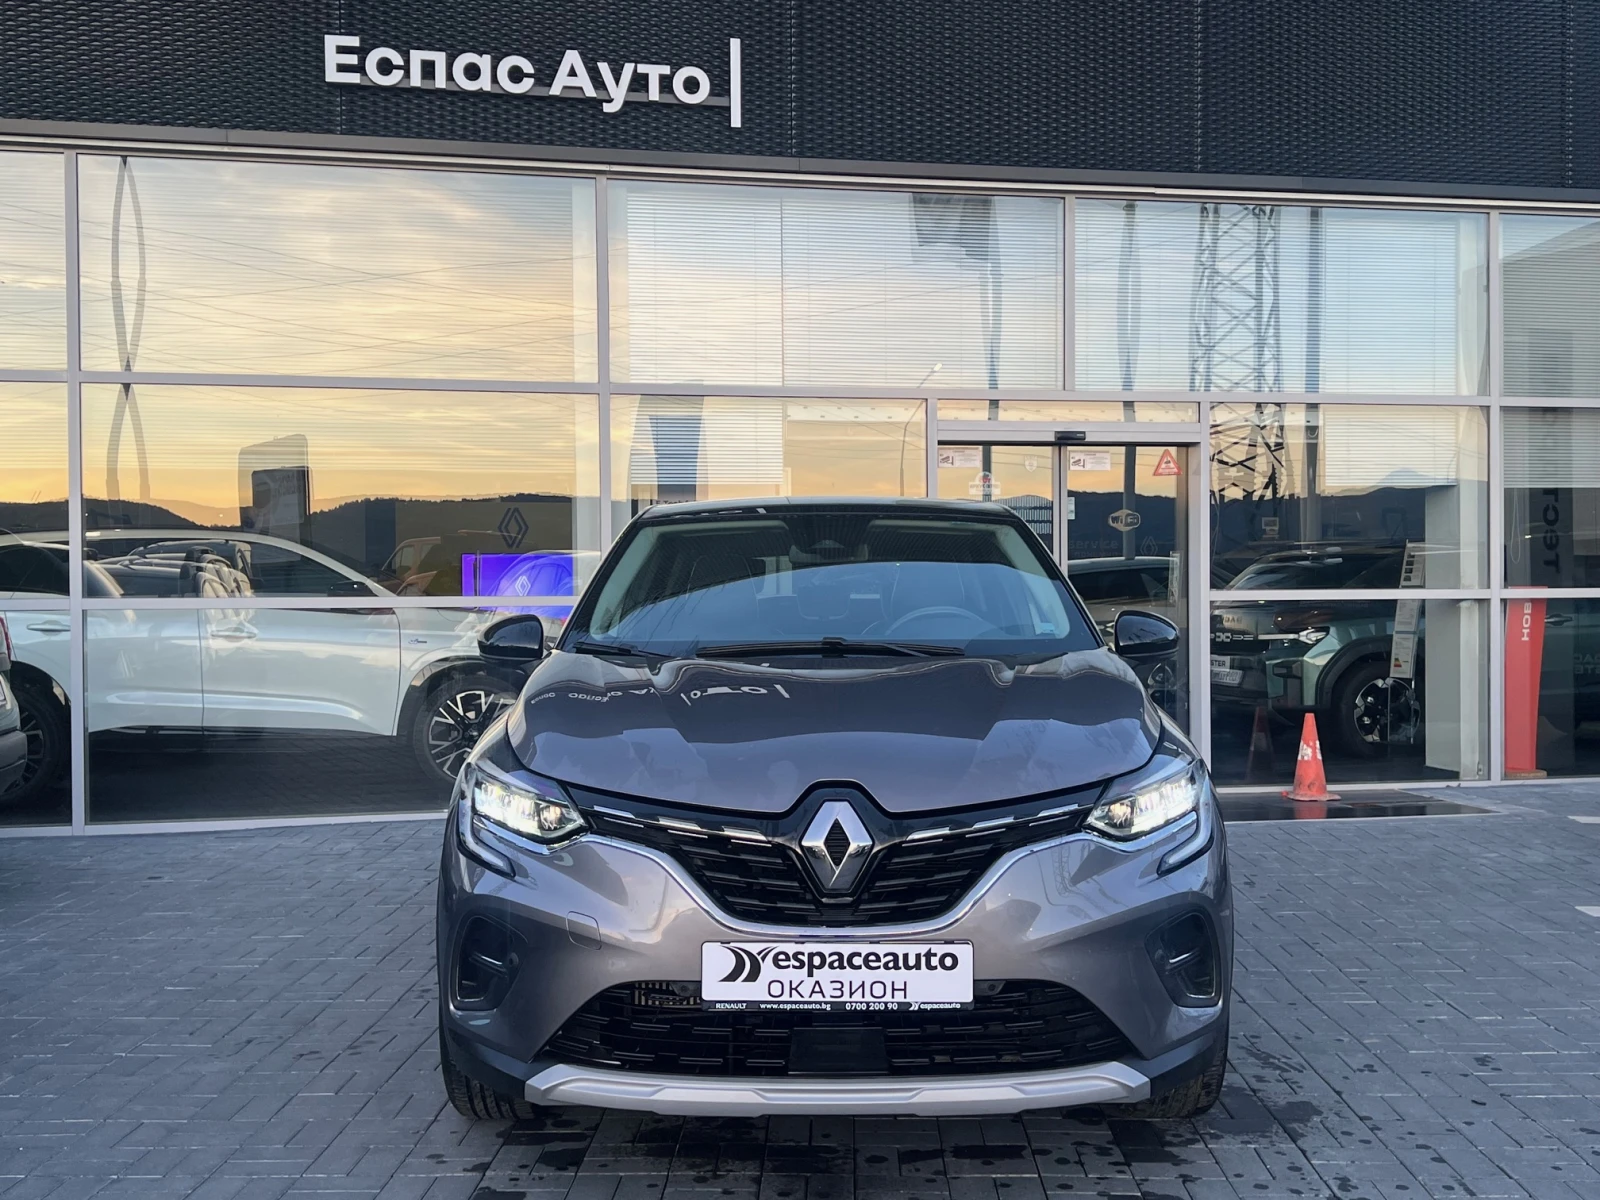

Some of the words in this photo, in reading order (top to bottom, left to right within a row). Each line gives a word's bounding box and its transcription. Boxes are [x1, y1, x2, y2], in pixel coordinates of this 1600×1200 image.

[324, 34, 535, 95] Еспас
[549, 48, 712, 113] Ауто
[772, 947, 959, 977] espaceauto
[767, 979, 908, 999] ОКАЗИОН
[759, 1003, 831, 1011] www.espaceauto.bg
[845, 1002, 867, 1011] 0700
[868, 1002, 885, 1011] 200
[886, 1002, 898, 1011] 90
[920, 1002, 961, 1010] espaceauto
